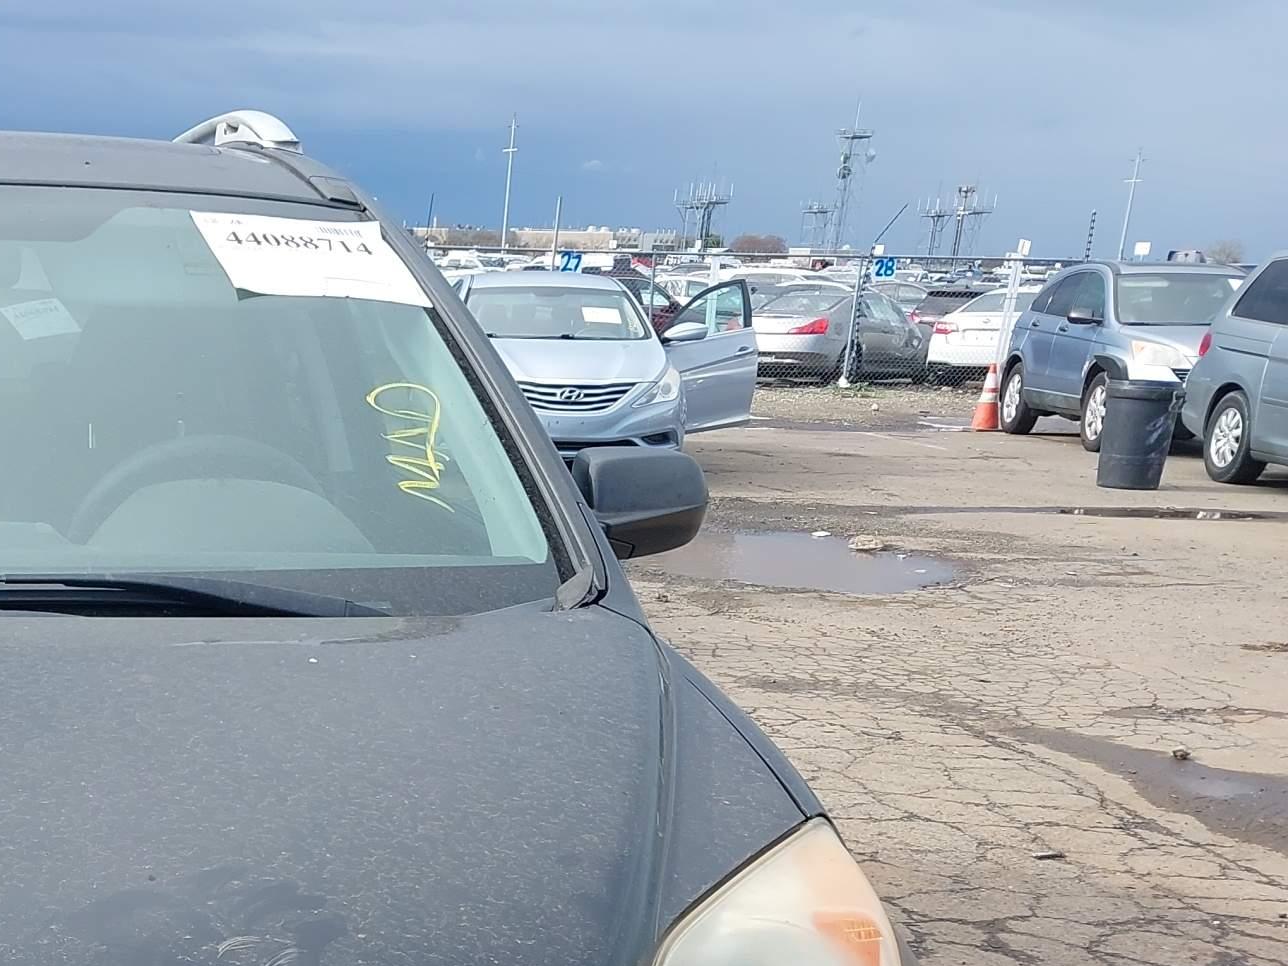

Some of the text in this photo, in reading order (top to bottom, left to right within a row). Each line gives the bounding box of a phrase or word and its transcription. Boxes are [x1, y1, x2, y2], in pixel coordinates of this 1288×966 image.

[225, 230, 373, 256] 44088714
[561, 251, 582, 272] 27
[874, 257, 896, 277] 28
